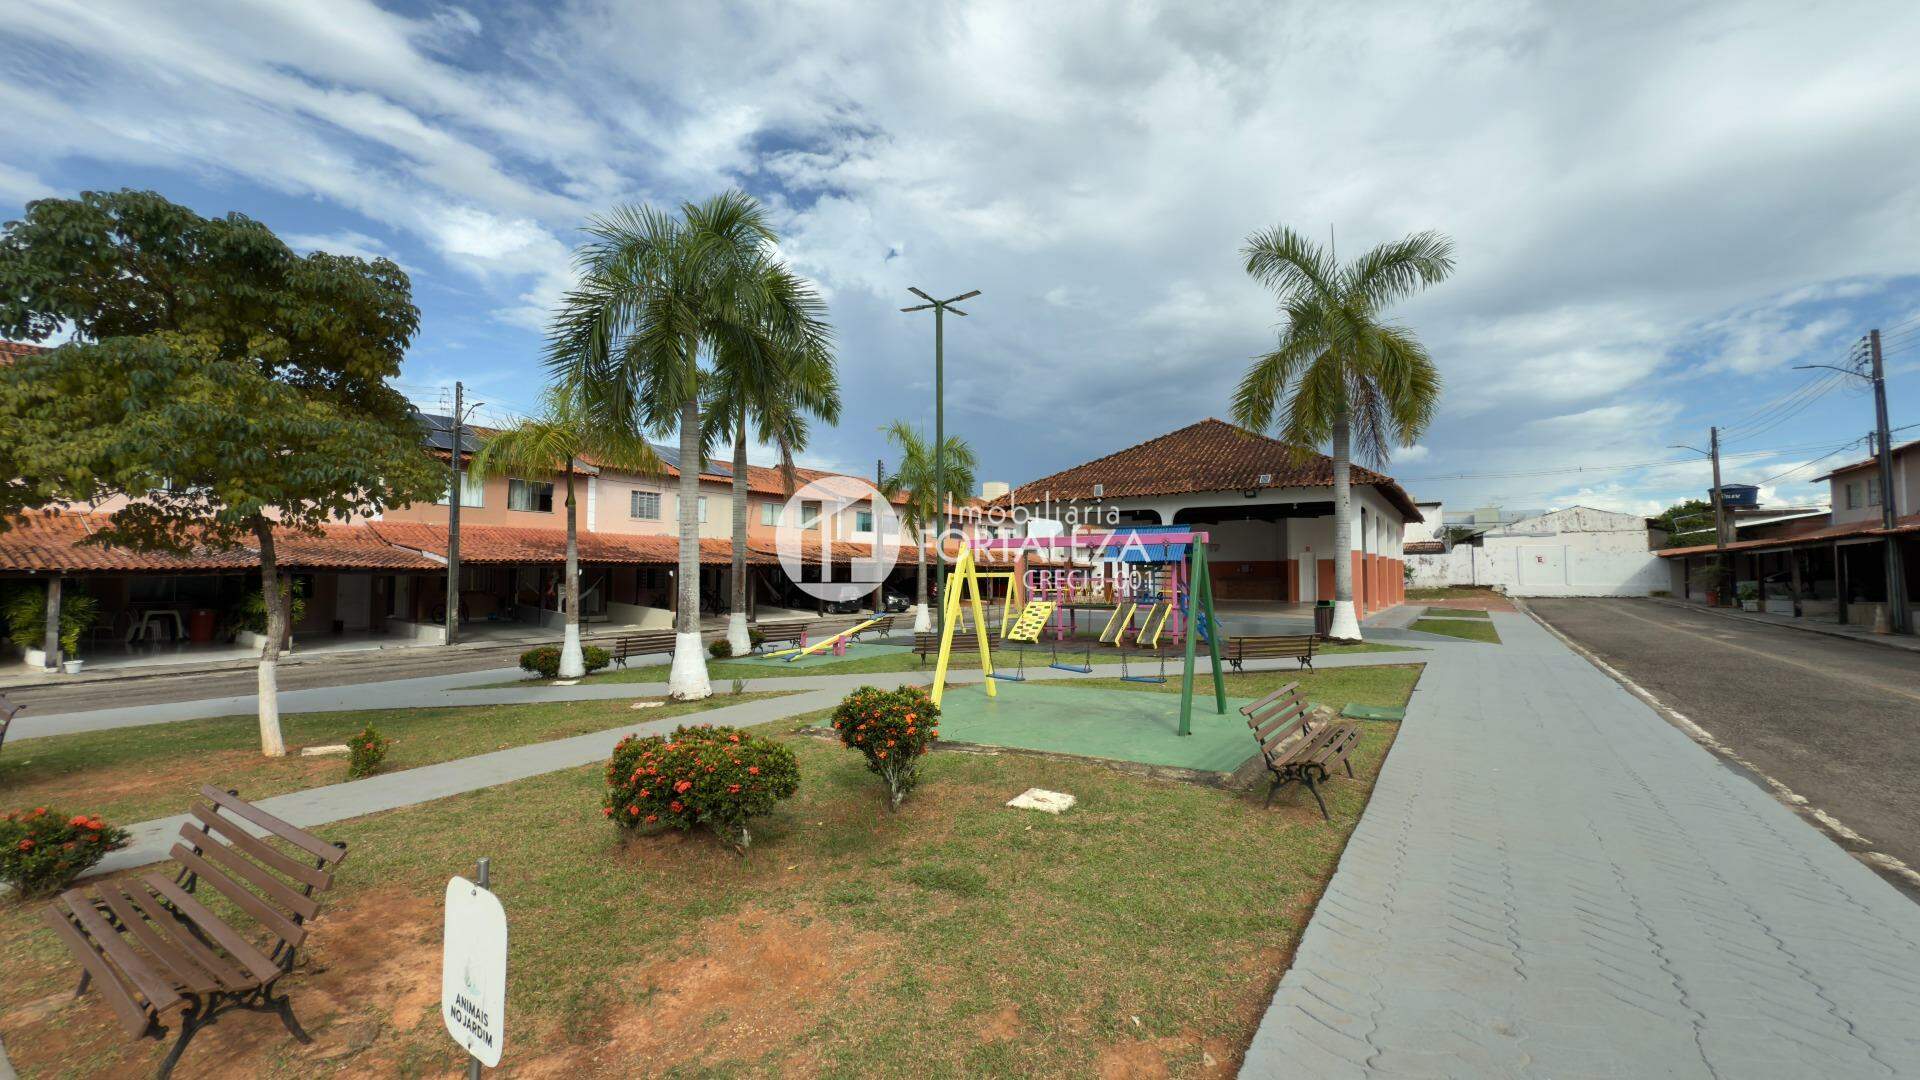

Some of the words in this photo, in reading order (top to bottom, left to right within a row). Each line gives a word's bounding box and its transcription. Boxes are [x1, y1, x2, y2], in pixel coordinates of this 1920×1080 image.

[450, 1005, 462, 1023] NO
[462, 1016, 493, 1048] JARDIM
[455, 993, 489, 1027] ANIMAIS
